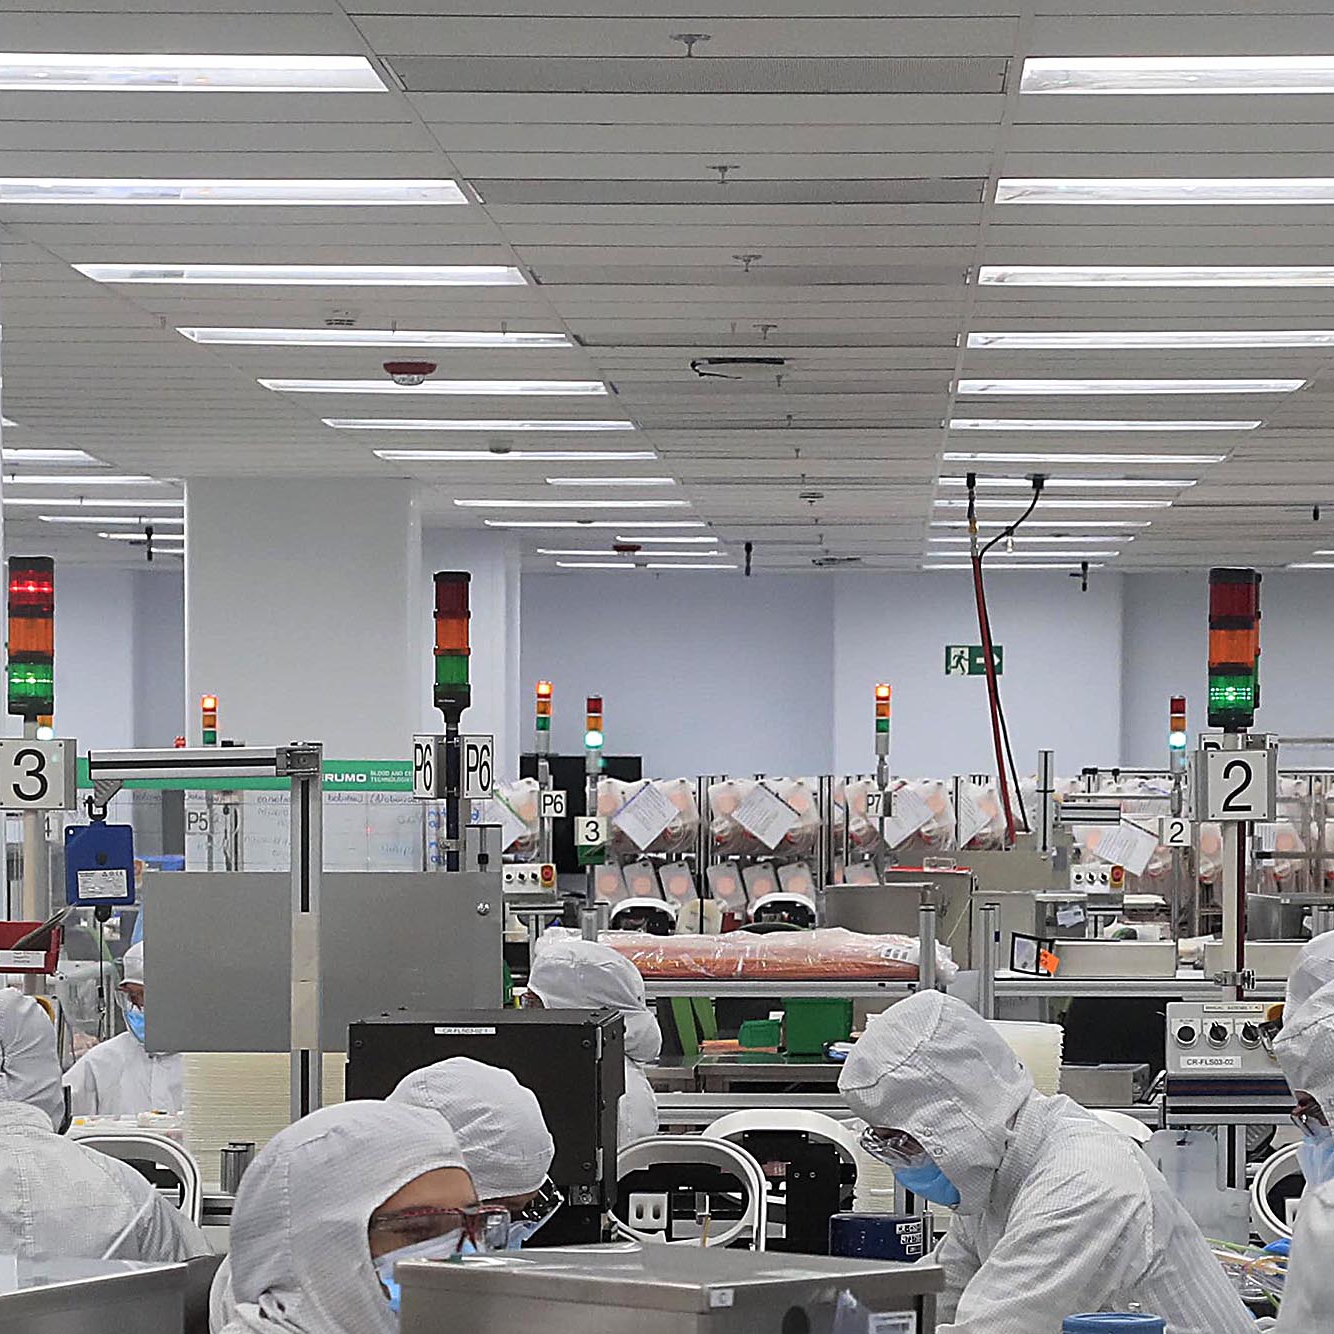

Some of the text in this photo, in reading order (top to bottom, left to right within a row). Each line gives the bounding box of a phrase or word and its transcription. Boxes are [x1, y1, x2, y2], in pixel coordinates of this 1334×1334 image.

[12, 748, 48, 802] 3
[414, 743, 433, 792] P6
[467, 744, 491, 792] P6
[1222, 759, 1252, 812] 2
[542, 794, 564, 815] P6
[866, 794, 881, 814] P7
[187, 812, 209, 831] P5
[585, 821, 600, 842] 3
[1169, 821, 1184, 843] 2
